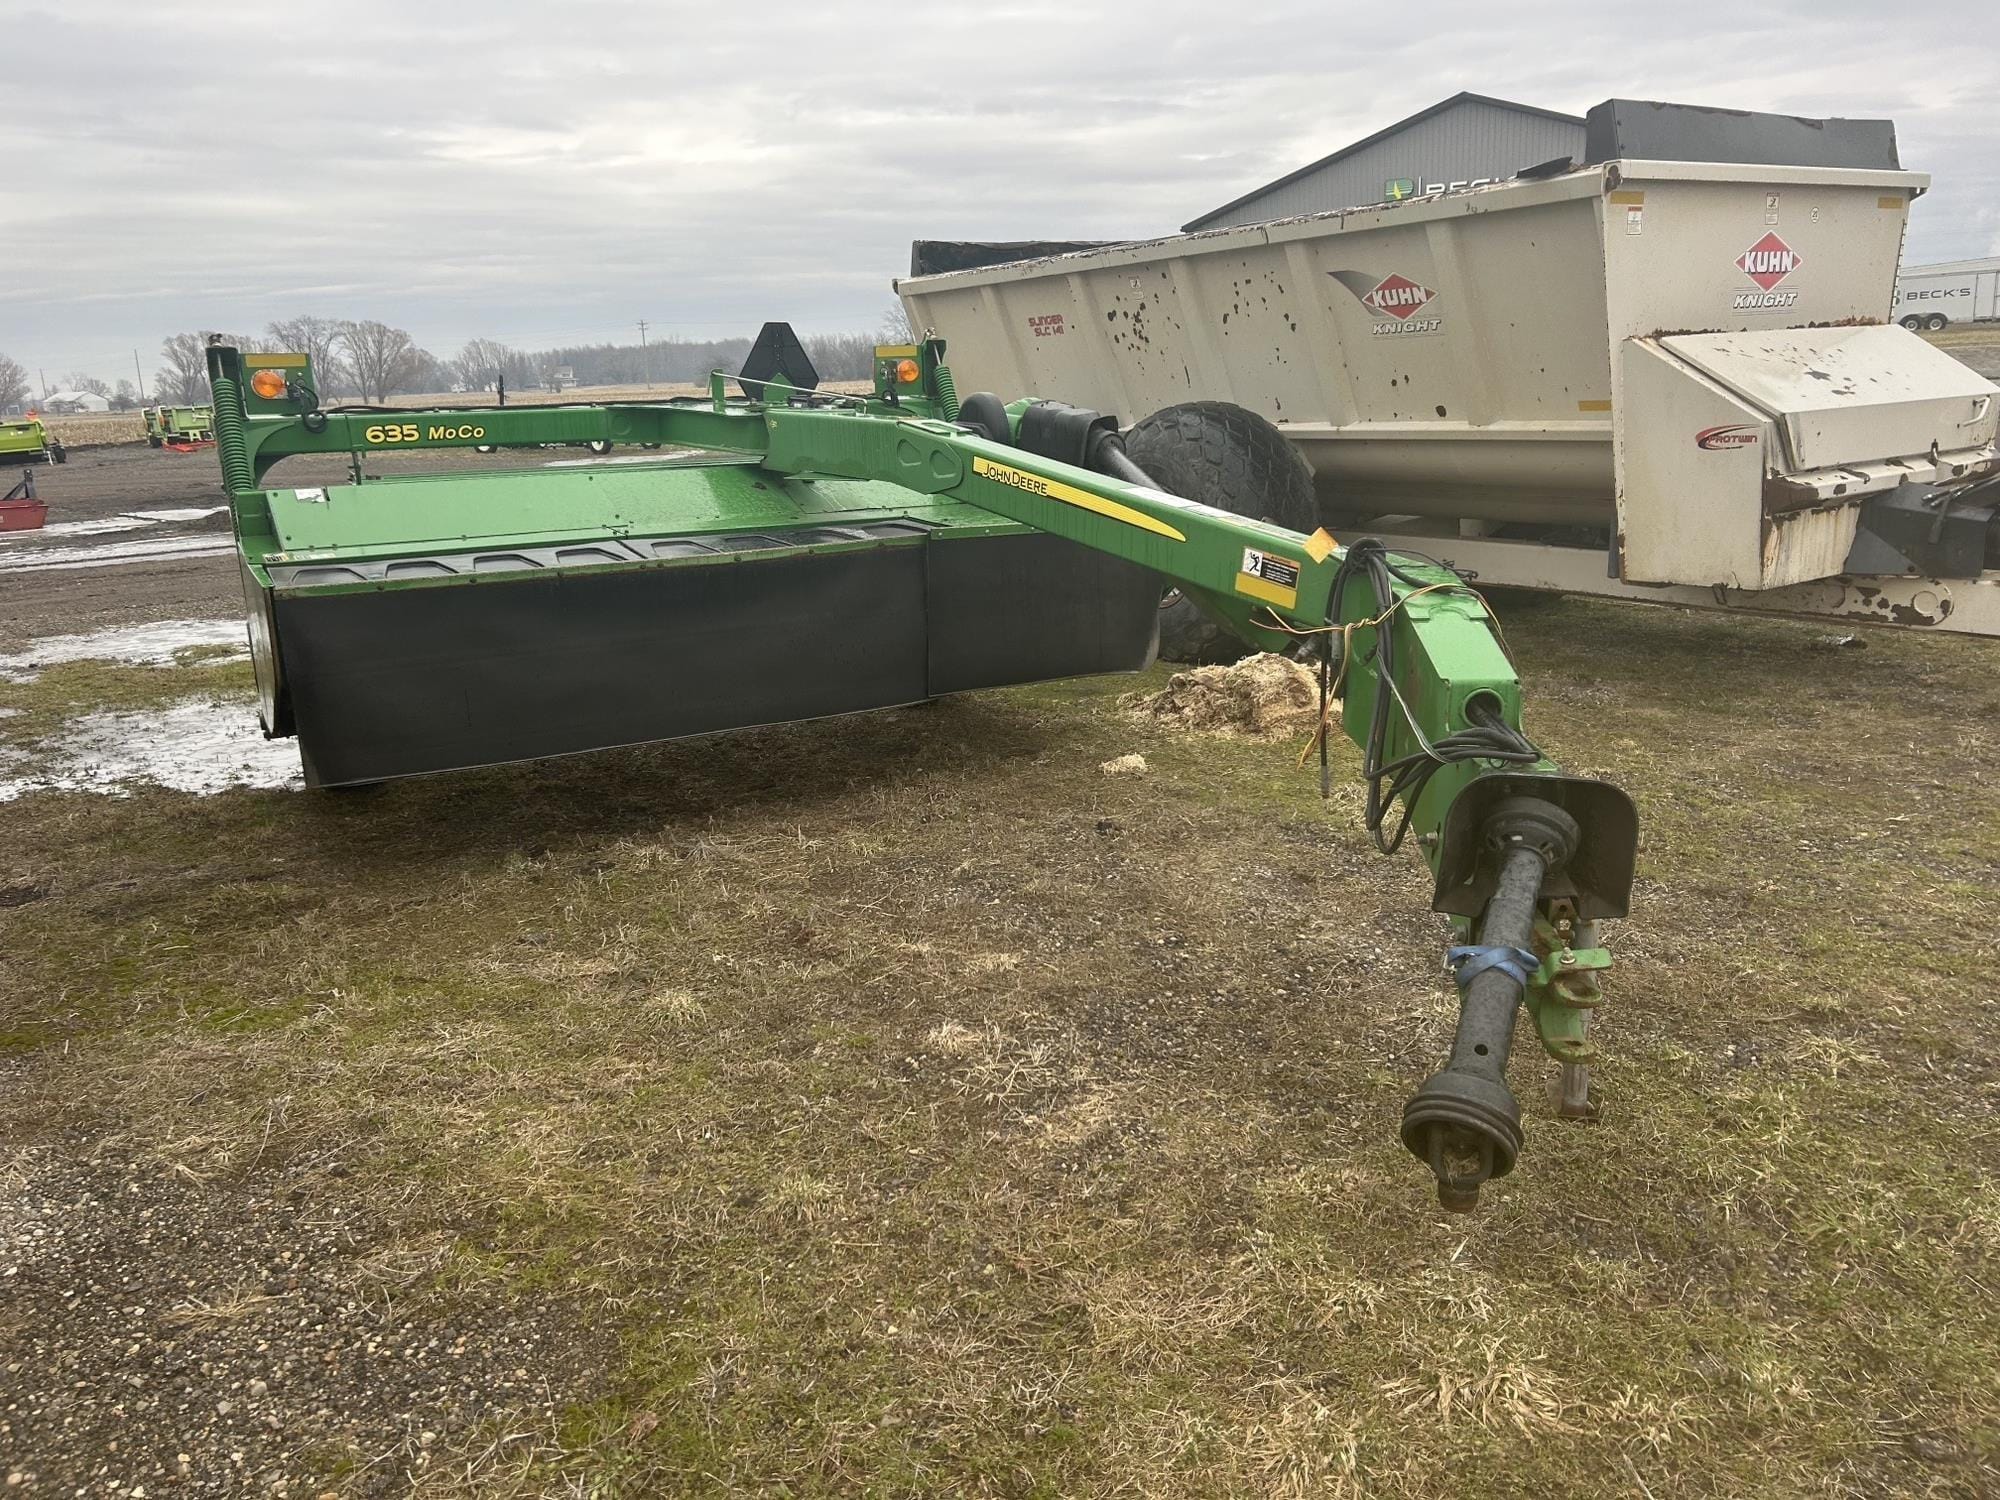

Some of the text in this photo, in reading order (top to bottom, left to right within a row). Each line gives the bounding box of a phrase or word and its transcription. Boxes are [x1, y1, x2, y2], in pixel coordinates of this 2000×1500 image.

[1744, 250, 1794, 275] KUHN
[1372, 286, 1427, 308] KUHN
[1732, 292, 1799, 309] KNIGHT
[1906, 287, 1971, 300] BECK'S
[1028, 313, 1064, 327] SLINGER
[1372, 319, 1442, 335] KNIGHT
[1034, 326, 1052, 337] SLC
[365, 423, 485, 443] 635 MoCo
[983, 463, 1048, 495] JOHN DEERE
